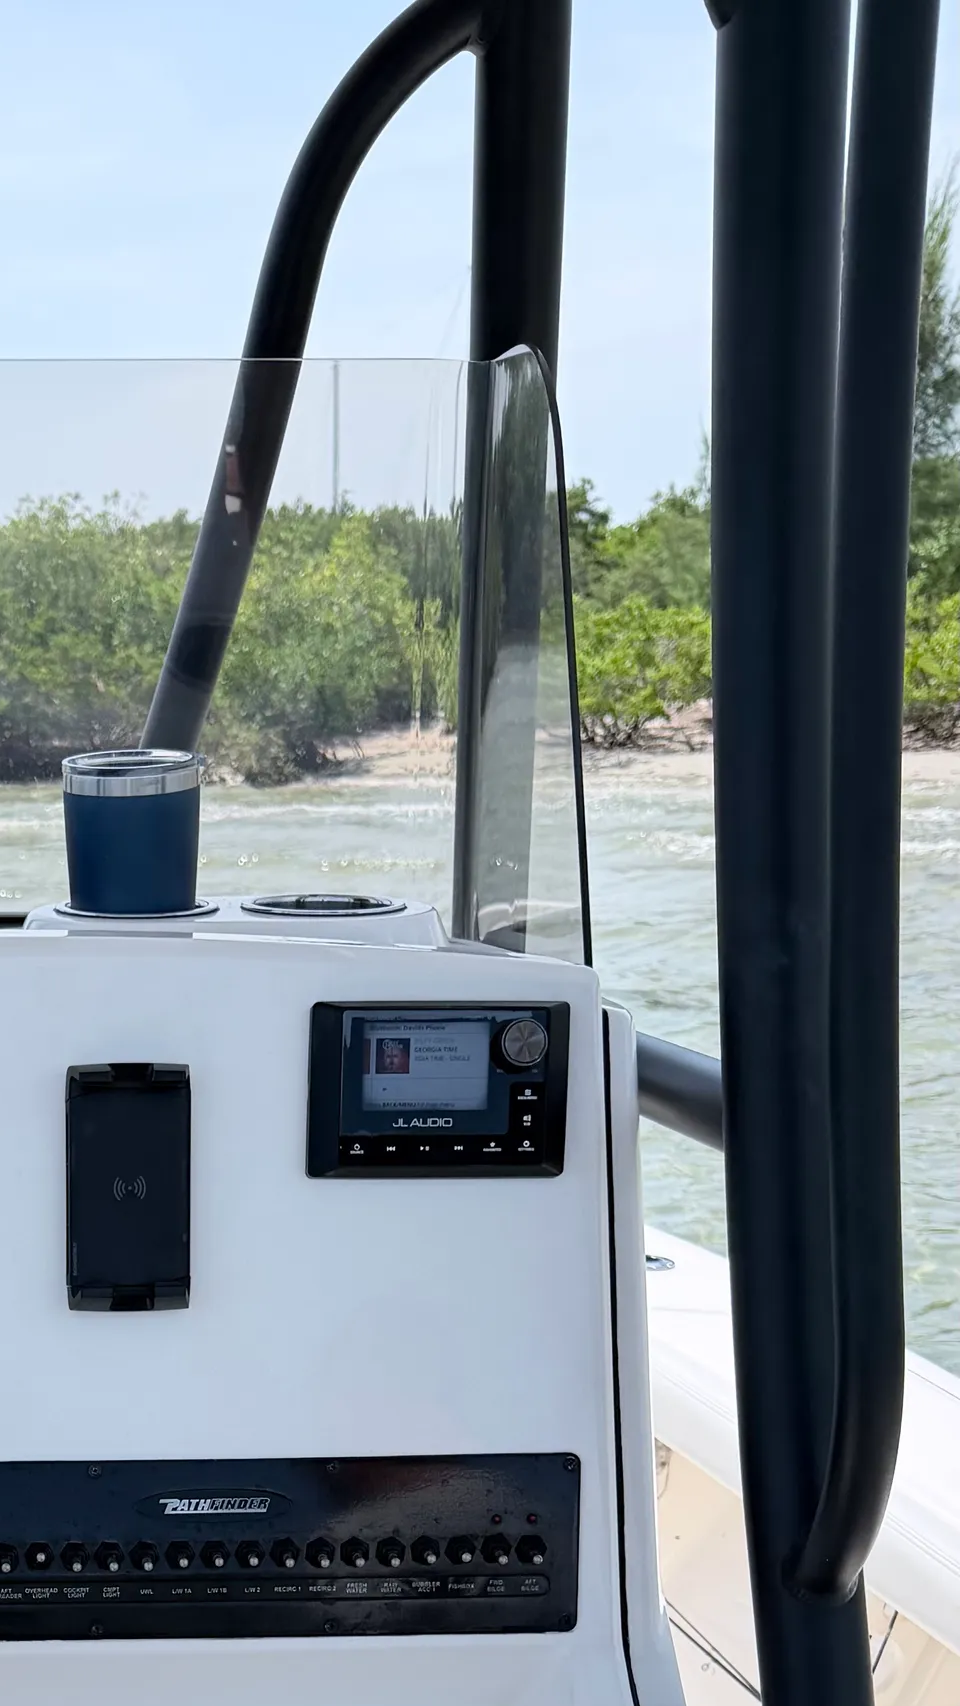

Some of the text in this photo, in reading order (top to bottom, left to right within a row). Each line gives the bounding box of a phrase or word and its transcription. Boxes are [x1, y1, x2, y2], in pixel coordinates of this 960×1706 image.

[392, 1118, 453, 1127] JL AUDIO
[159, 1498, 270, 1514] PATHFINDER
